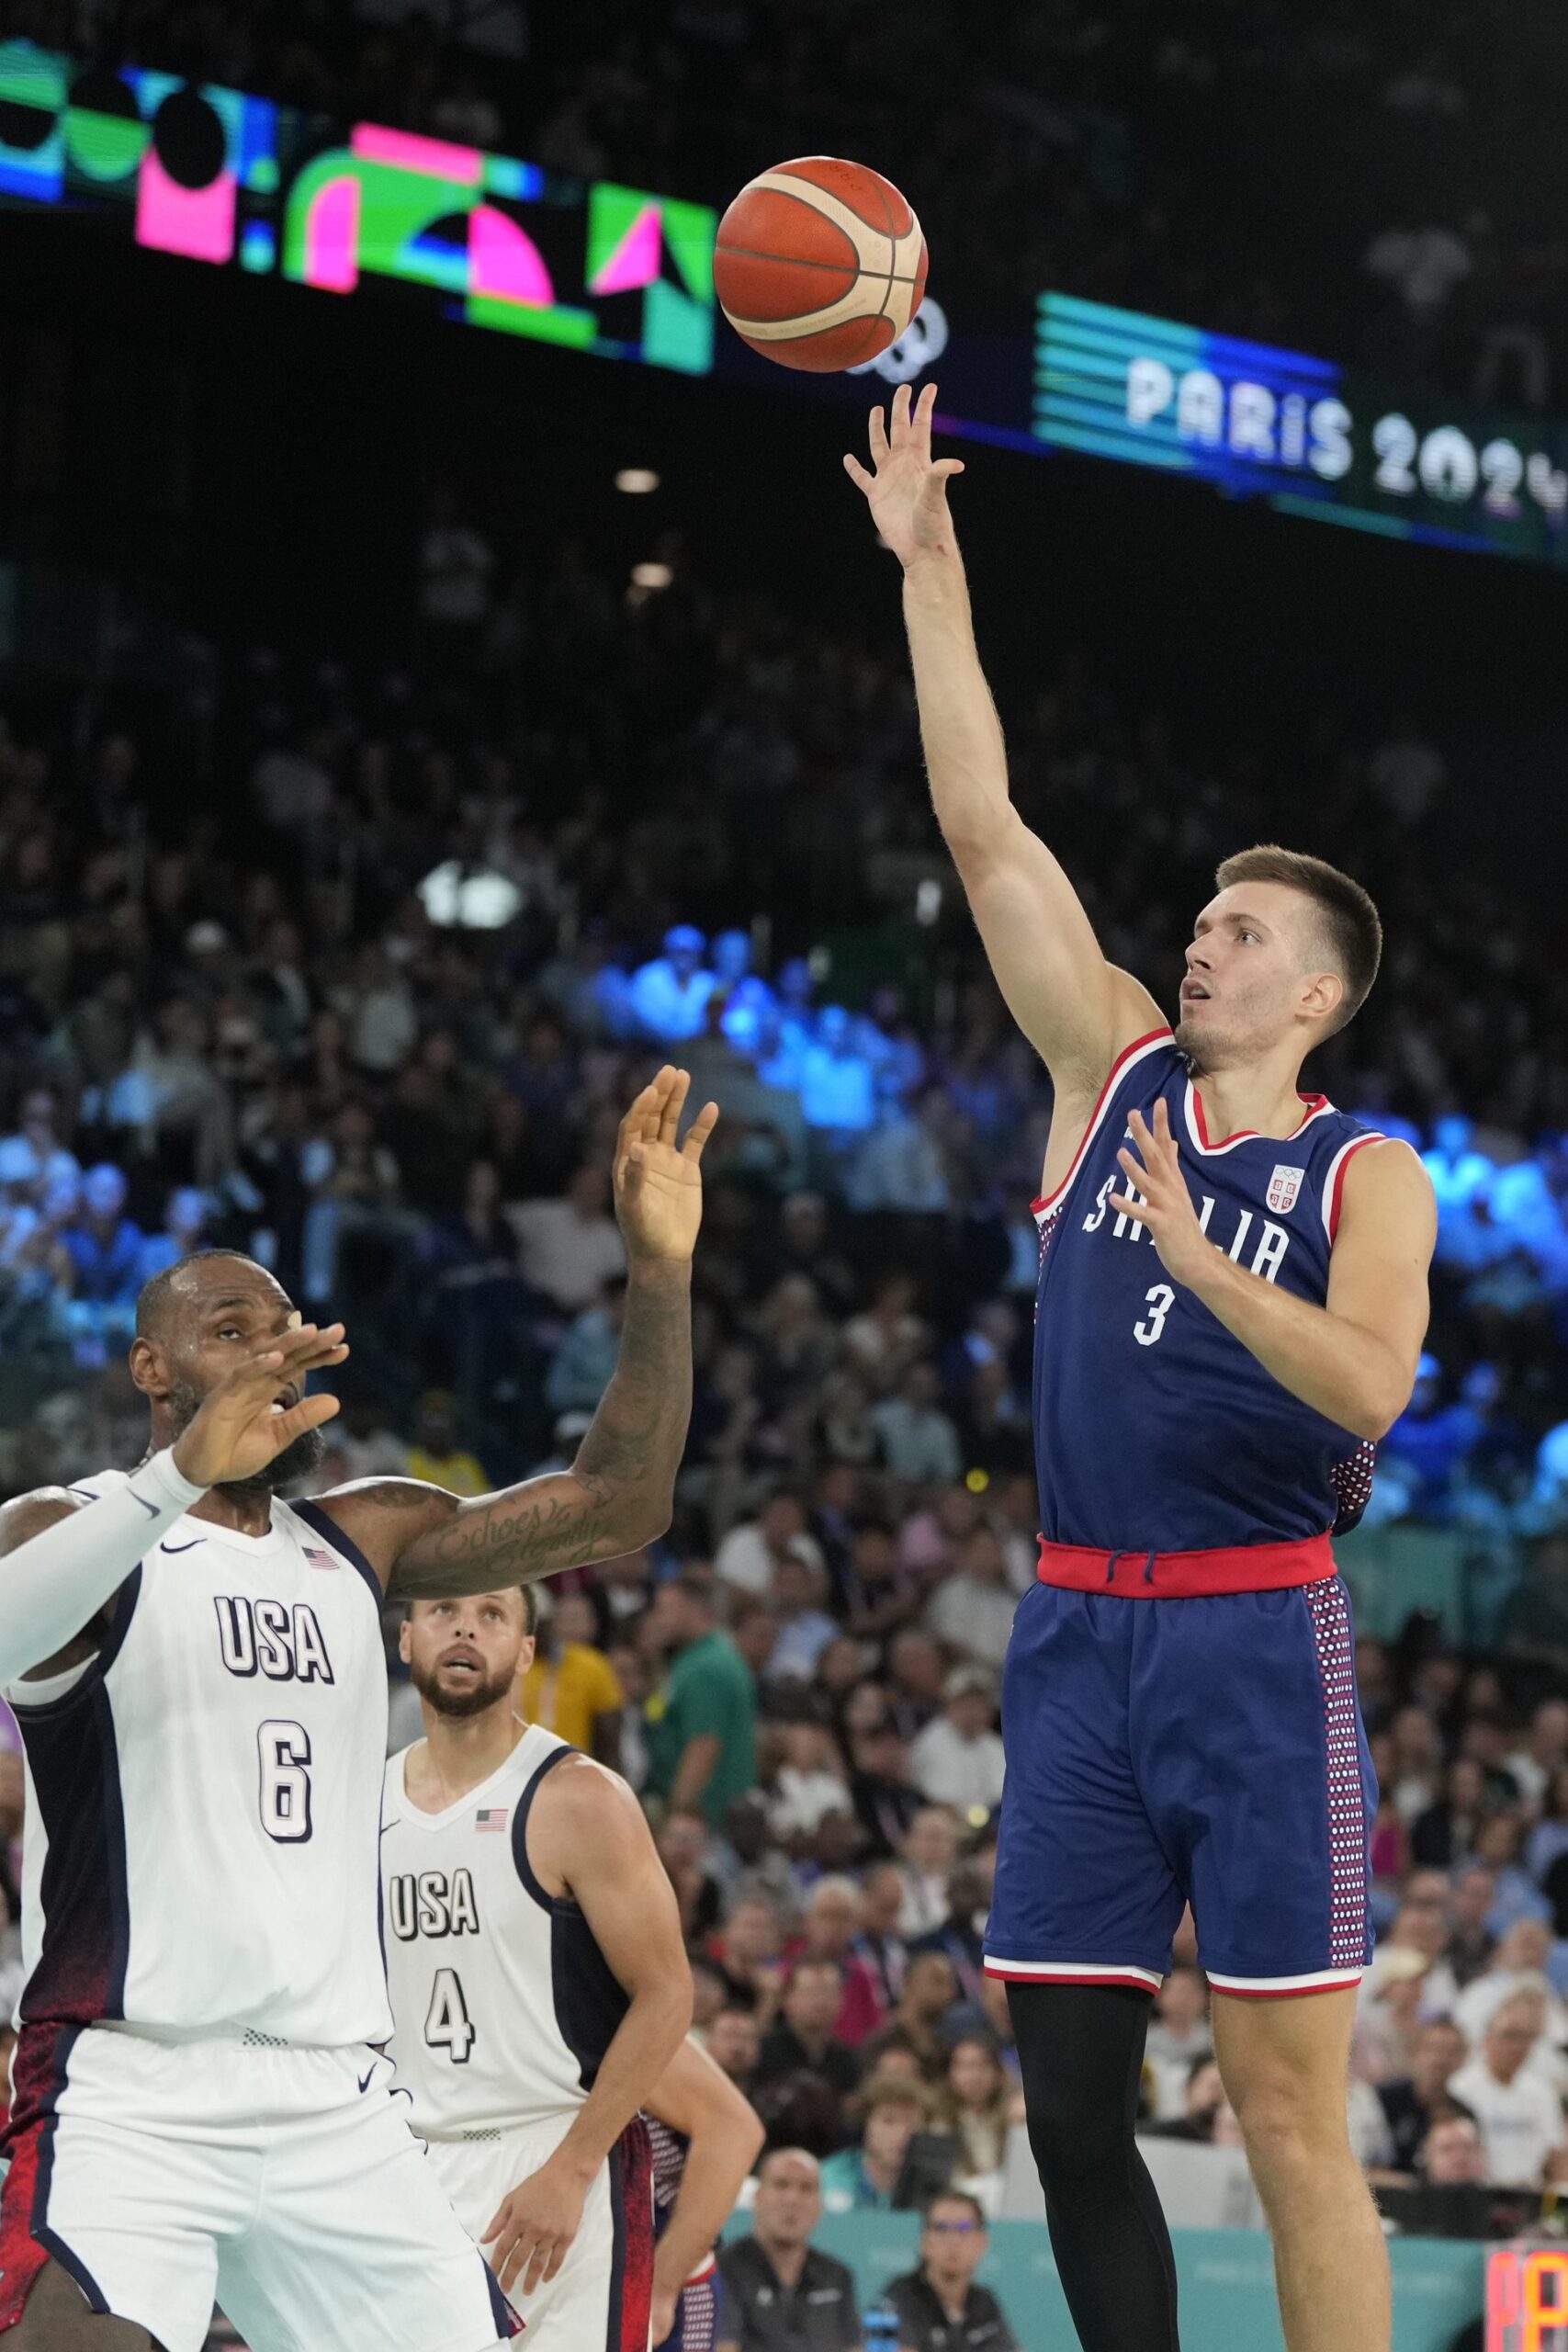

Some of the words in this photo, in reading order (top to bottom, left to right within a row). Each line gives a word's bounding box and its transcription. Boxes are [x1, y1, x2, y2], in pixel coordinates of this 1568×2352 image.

[1126, 356, 1353, 481] PARIS
[1371, 412, 1568, 531] 2024
[1081, 1174, 1290, 1284] SRIJA
[1133, 1283, 1176, 1346] 3
[213, 1596, 334, 1685] USA
[256, 1719, 312, 1844] 6
[389, 1868, 479, 1941] USA
[423, 1968, 475, 2064] 4
